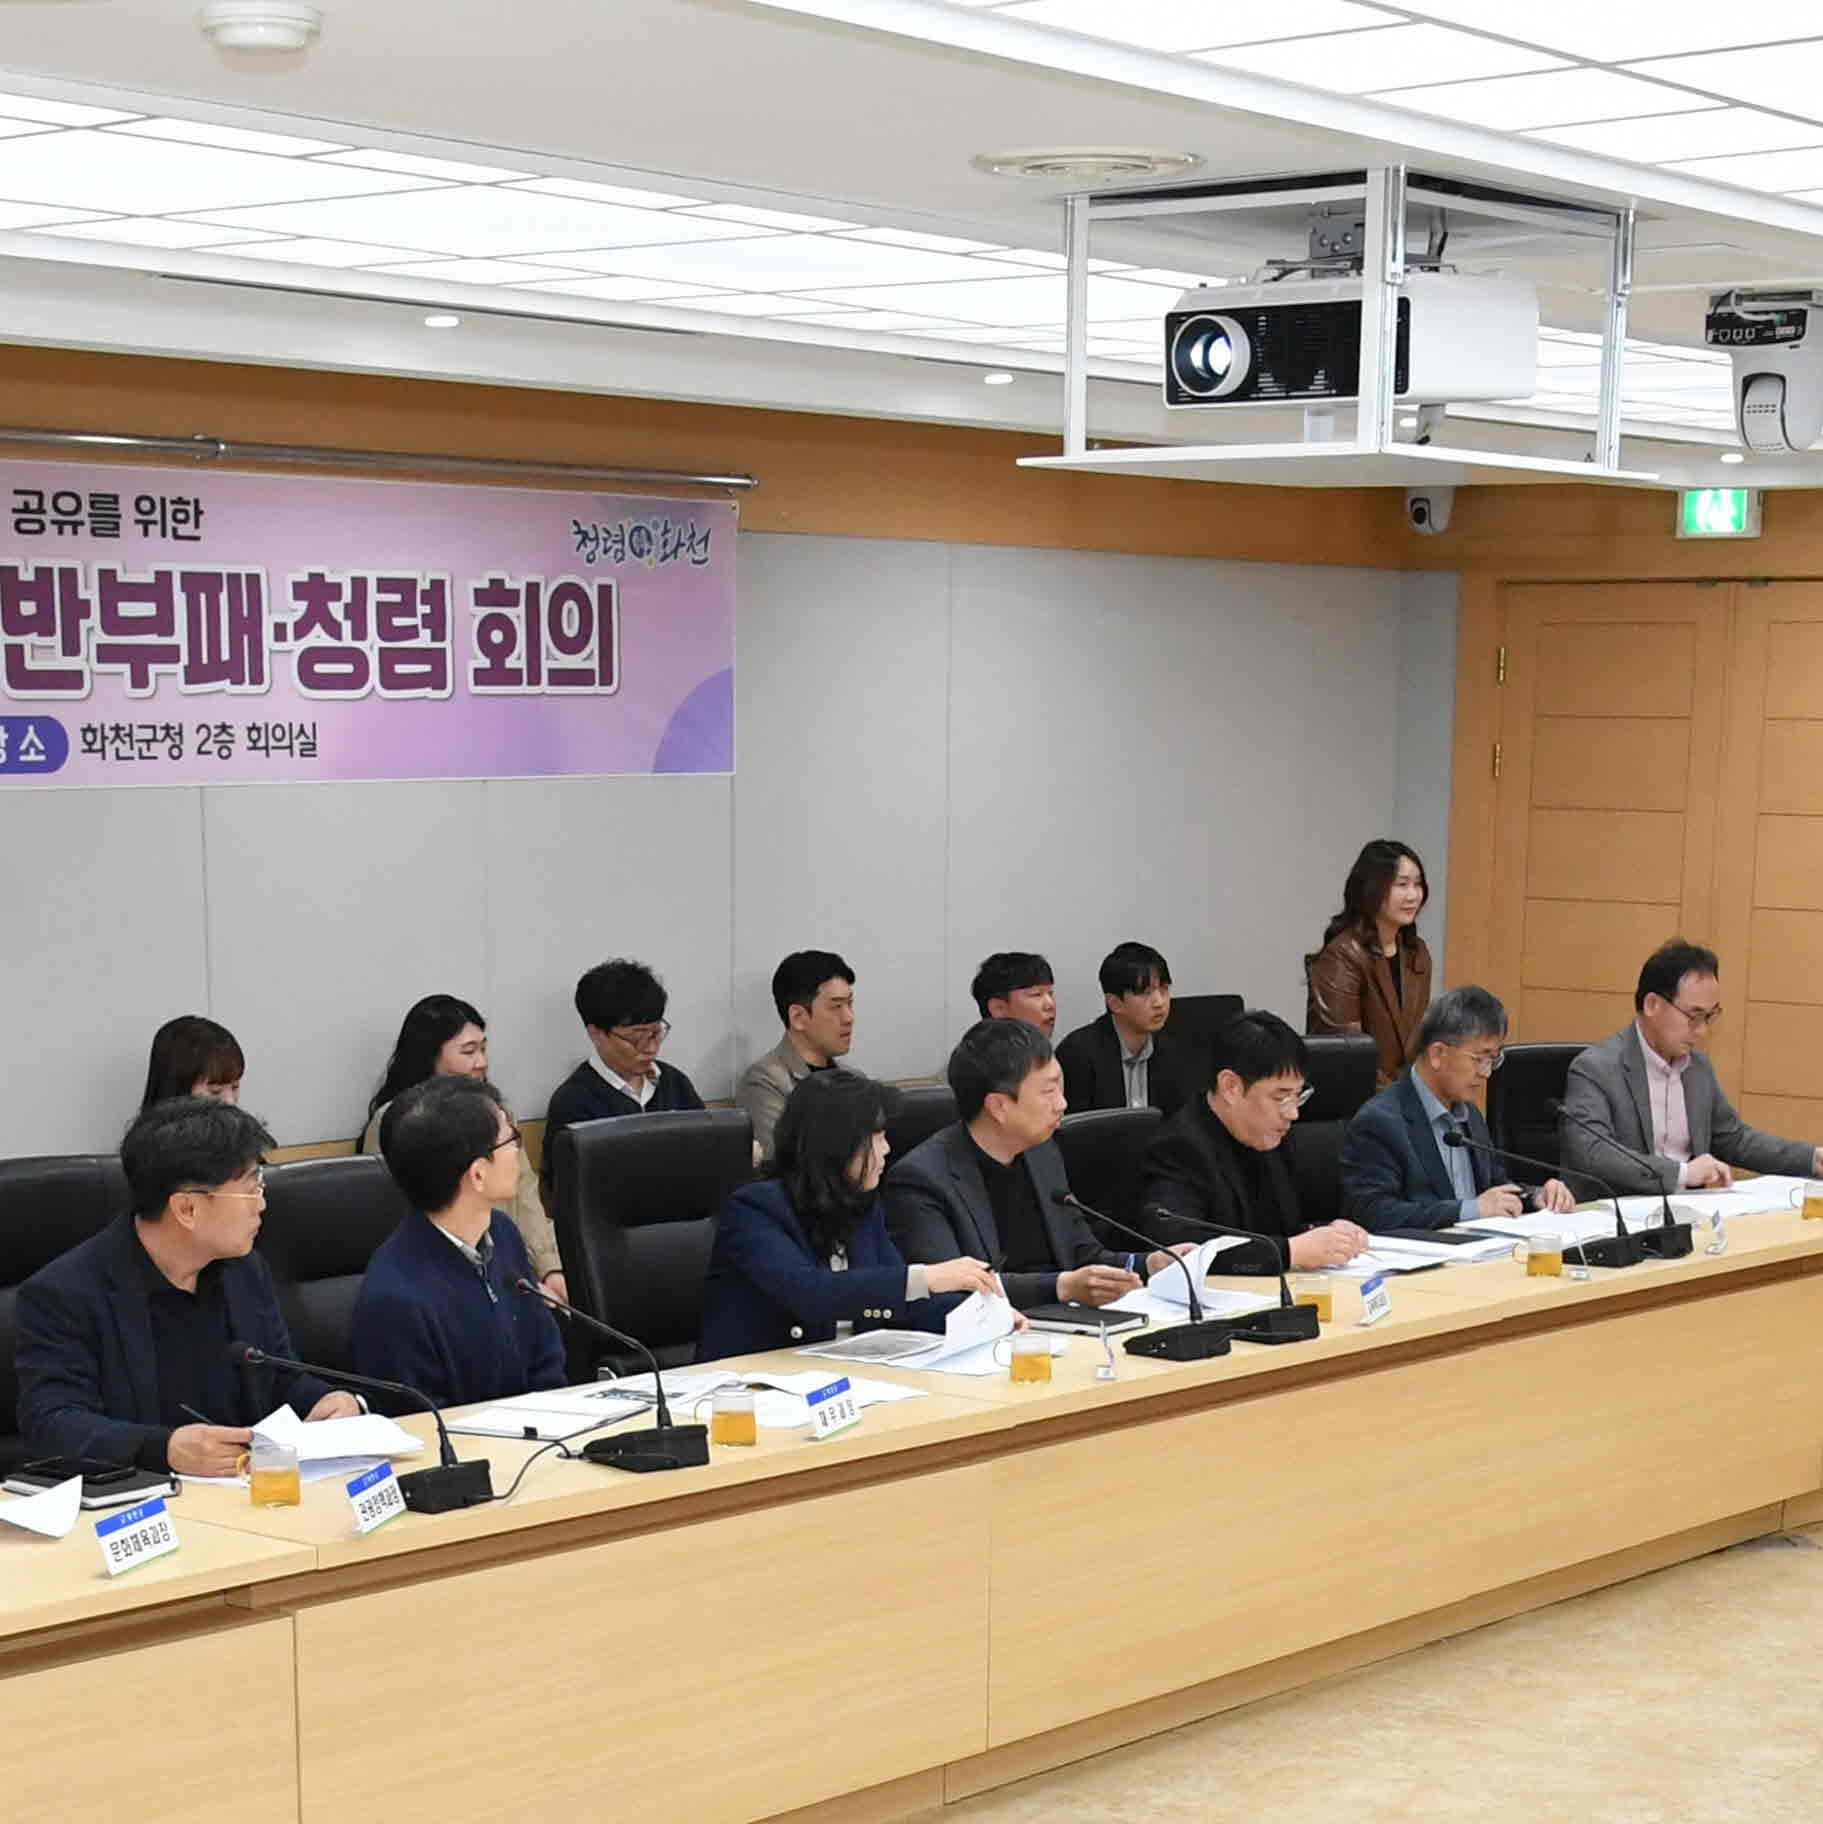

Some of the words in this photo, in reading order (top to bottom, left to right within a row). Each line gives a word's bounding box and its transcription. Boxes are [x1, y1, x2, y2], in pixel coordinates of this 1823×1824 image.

[11, 488, 122, 538] 공유를
[133, 494, 205, 541] 위한
[473, 578, 615, 687] 회의
[81, 723, 184, 761] 화천군청
[196, 722, 235, 760] 2층
[245, 722, 318, 758] 회의실
[109, 1520, 171, 1563] 문화체육과장
